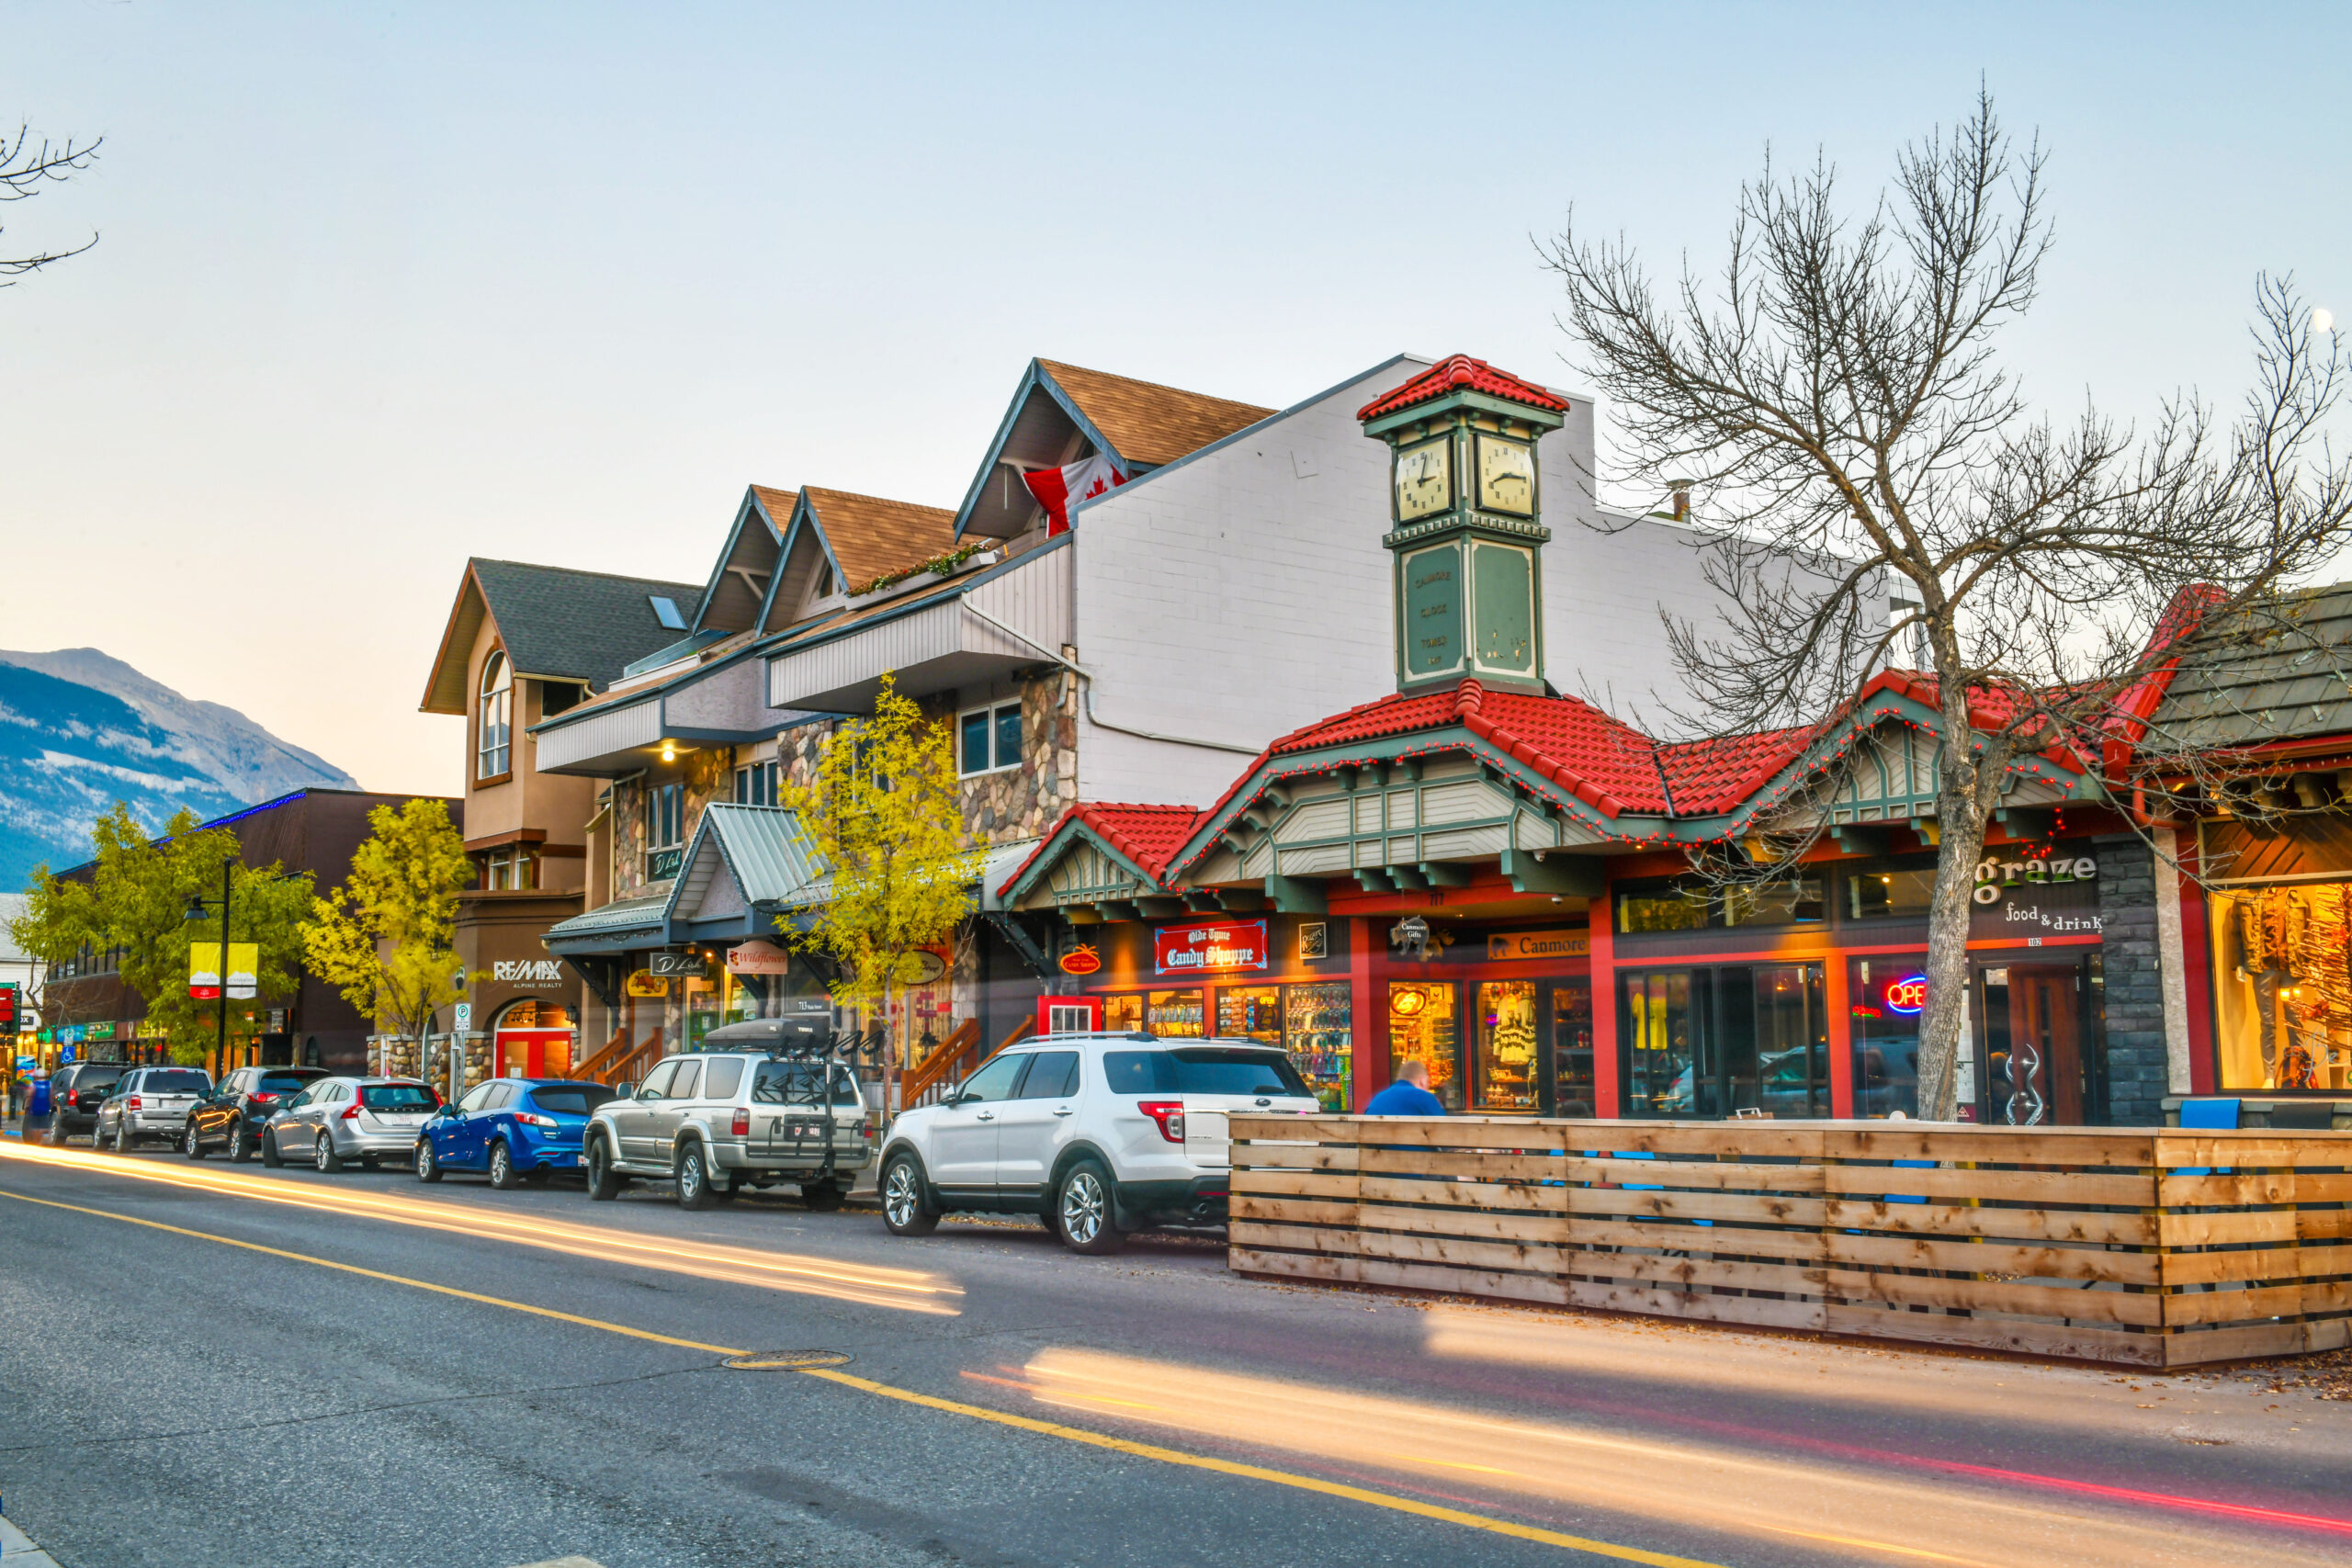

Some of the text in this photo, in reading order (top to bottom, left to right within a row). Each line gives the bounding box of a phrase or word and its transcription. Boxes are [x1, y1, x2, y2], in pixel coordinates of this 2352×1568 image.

[1973, 856, 2098, 905] graze
[2006, 901, 2103, 931] food & drink
[1401, 922, 1427, 931] Canmore
[1408, 931, 1421, 939] Gifts
[1188, 928, 1231, 944] Olde Tyme
[1519, 936, 1586, 954] Canmore
[740, 951, 786, 969] Wildflower
[1167, 945, 1253, 968] Candy Shoppe
[1259, 996, 1275, 1005] OPEN
[1887, 984, 1926, 1005] OPE
